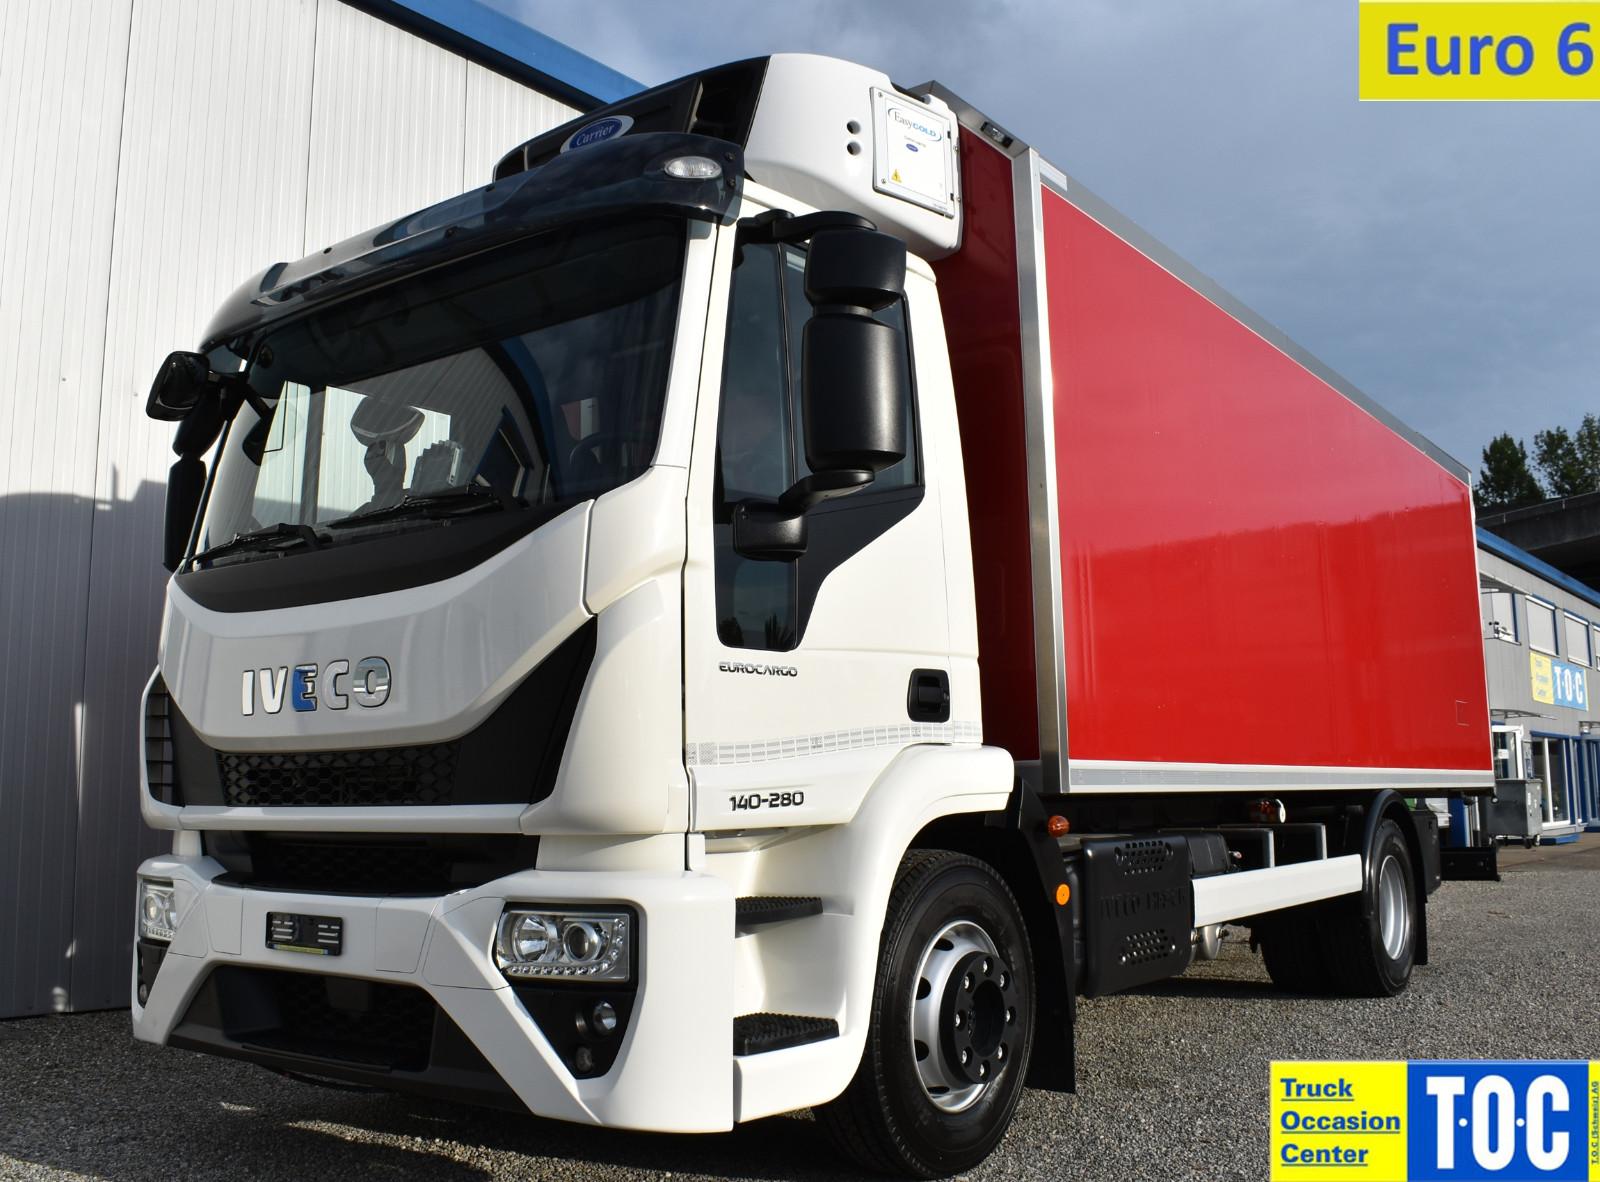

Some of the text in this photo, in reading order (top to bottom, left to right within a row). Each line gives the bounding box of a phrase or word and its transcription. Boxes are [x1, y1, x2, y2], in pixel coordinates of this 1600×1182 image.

[576, 124, 615, 146] Carrier
[719, 661, 799, 678] EUROCARGO
[240, 655, 392, 717] IVECO
[728, 790, 805, 812] 140-280
